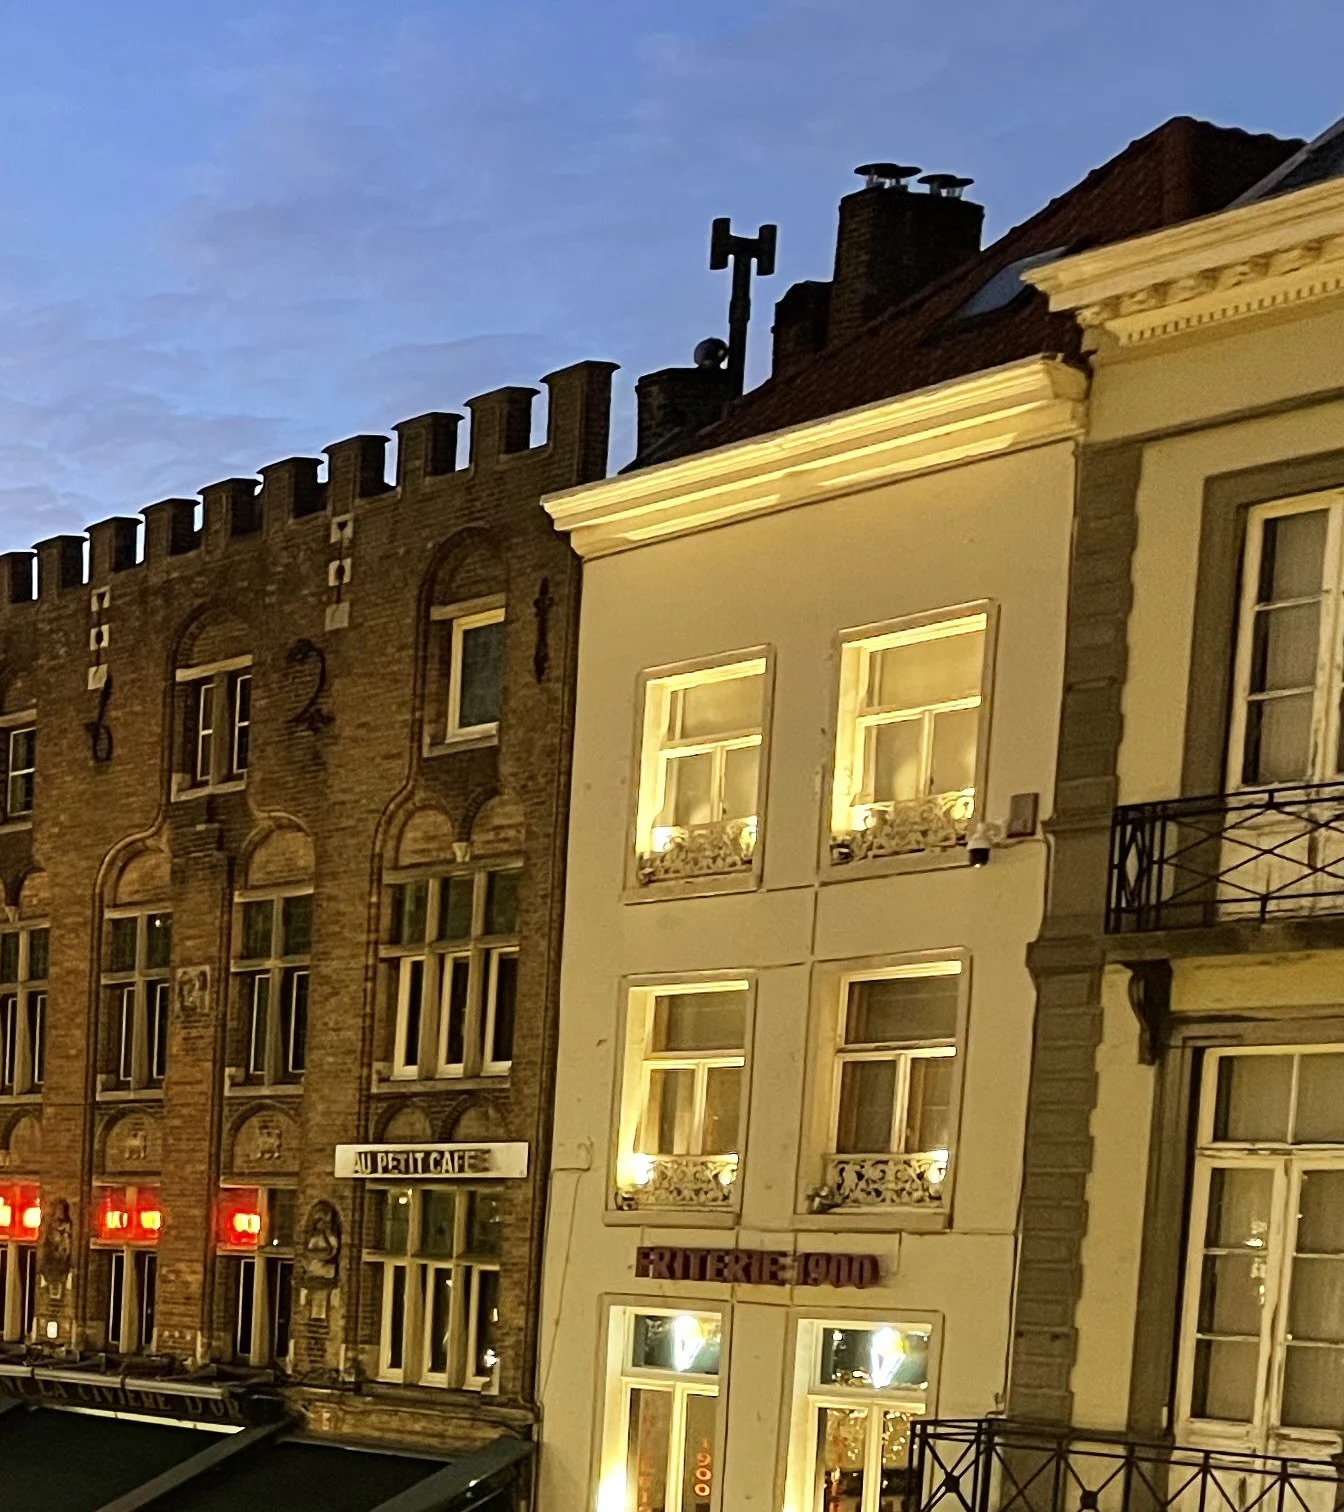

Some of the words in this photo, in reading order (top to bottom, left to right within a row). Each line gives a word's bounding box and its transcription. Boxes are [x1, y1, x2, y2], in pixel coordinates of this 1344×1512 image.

[354, 1152, 373, 1176] AU
[377, 1151, 425, 1176] PETIT
[635, 1246, 789, 1287] FRITERIE
[795, 1252, 882, 1290] 1900
